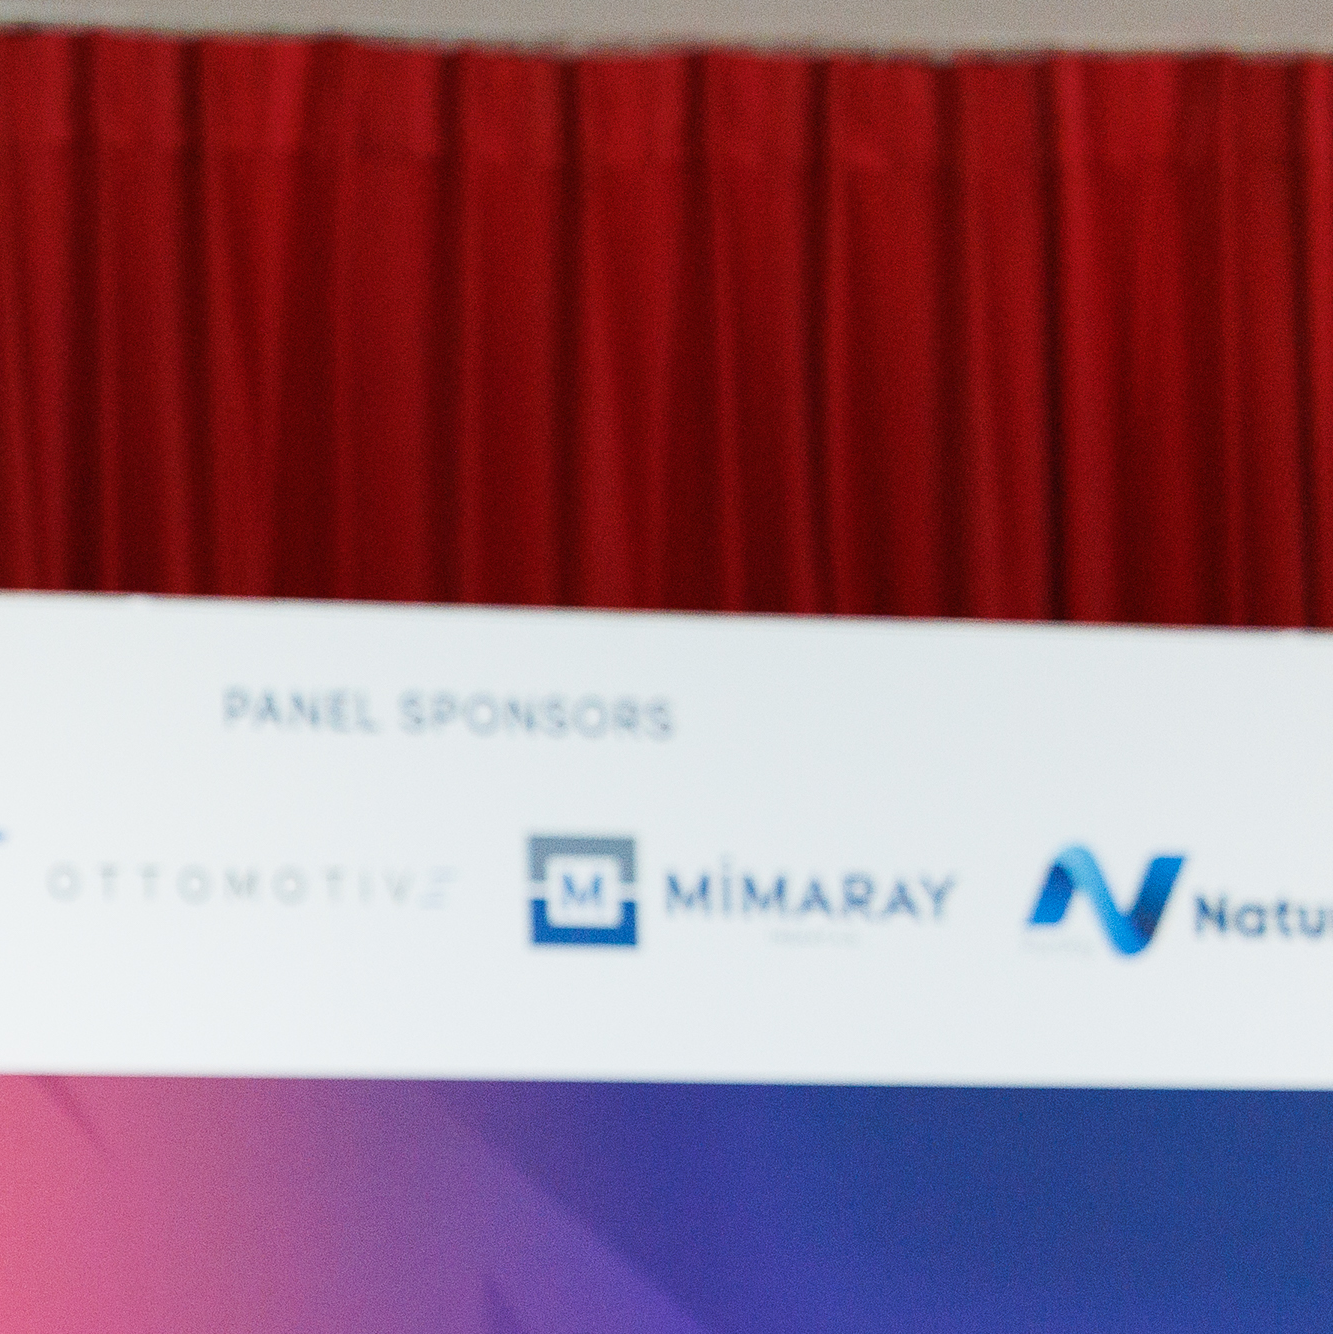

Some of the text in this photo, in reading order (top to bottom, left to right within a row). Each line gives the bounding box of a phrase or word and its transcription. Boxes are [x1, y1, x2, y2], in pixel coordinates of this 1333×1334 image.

[222, 686, 675, 741] PANEL SPONSORS
[45, 859, 461, 911] OTTOMOTIVE
[1194, 892, 1333, 941] Natu
